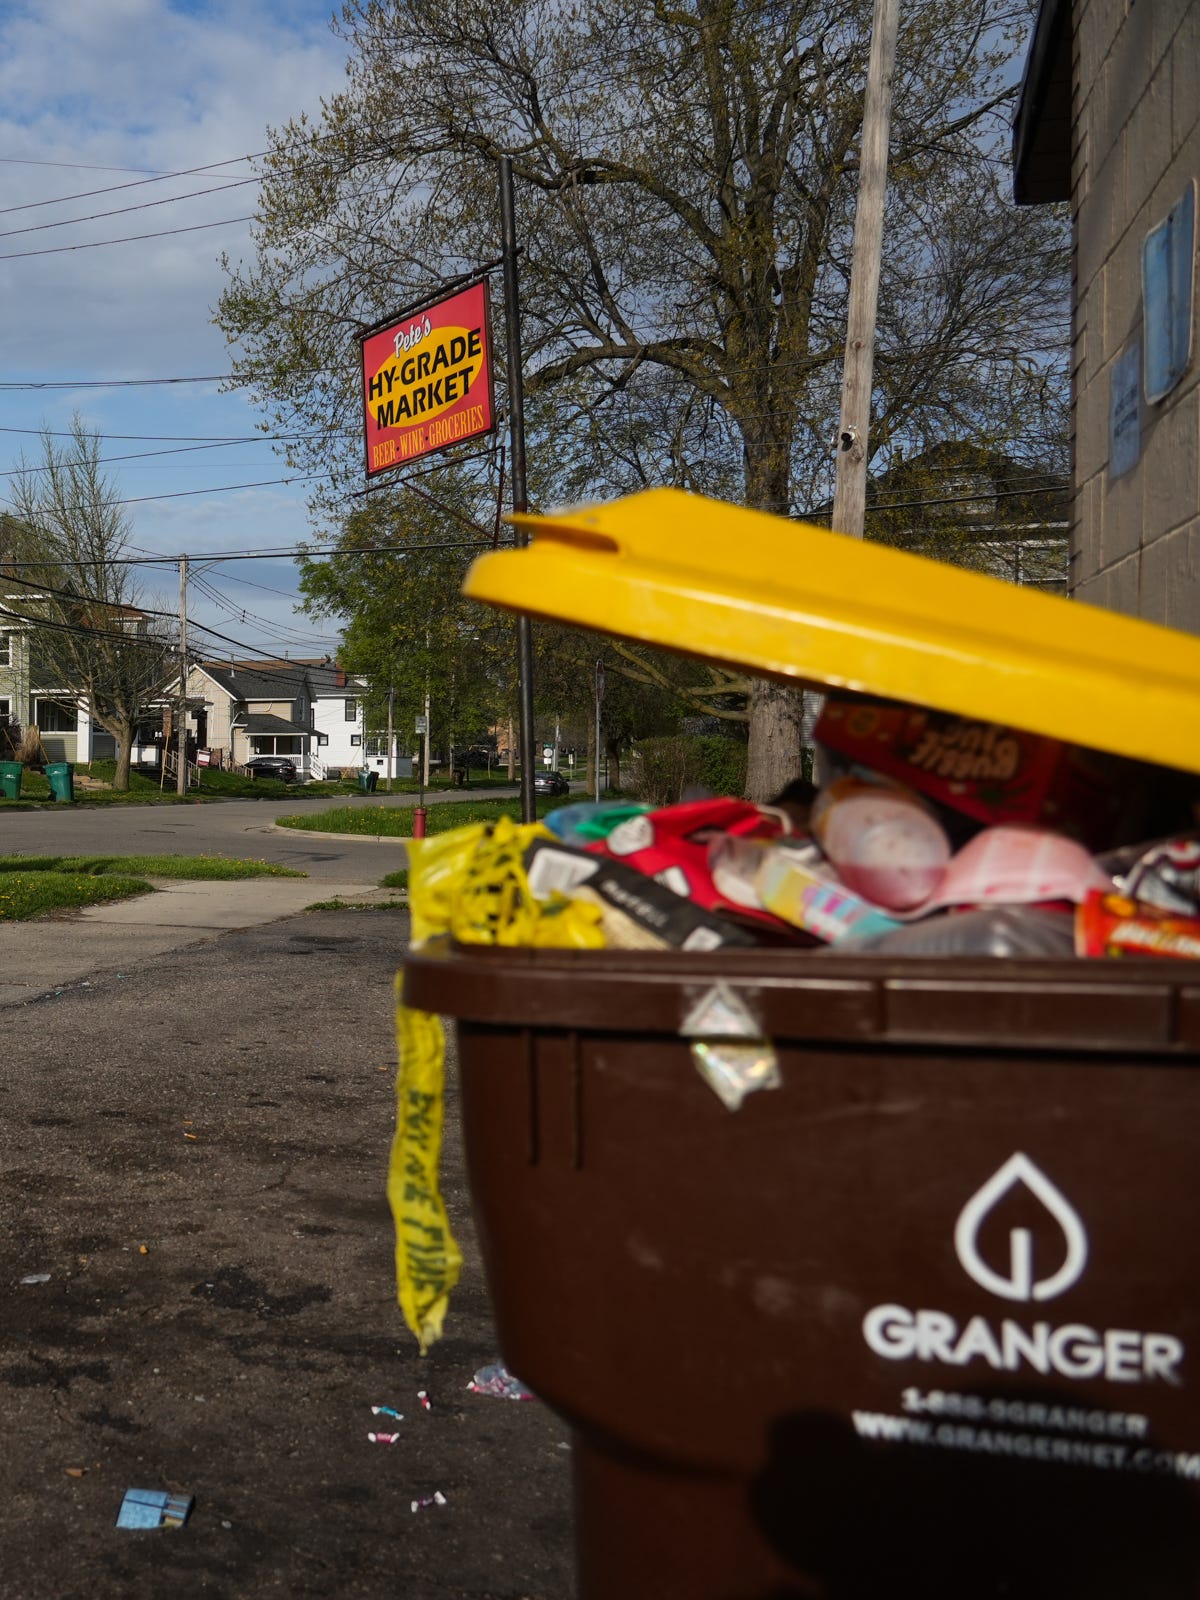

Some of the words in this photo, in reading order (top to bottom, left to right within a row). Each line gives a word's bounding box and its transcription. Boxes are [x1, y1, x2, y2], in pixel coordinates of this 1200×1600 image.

[368, 327, 482, 402] HY-GRADE
[393, 315, 432, 358] Pete's
[377, 365, 474, 430] MARKET
[372, 439, 396, 468] BEER
[399, 427, 425, 455] WINE
[428, 404, 485, 446] GROCERIES
[862, 1303, 1185, 1387] GRANGER
